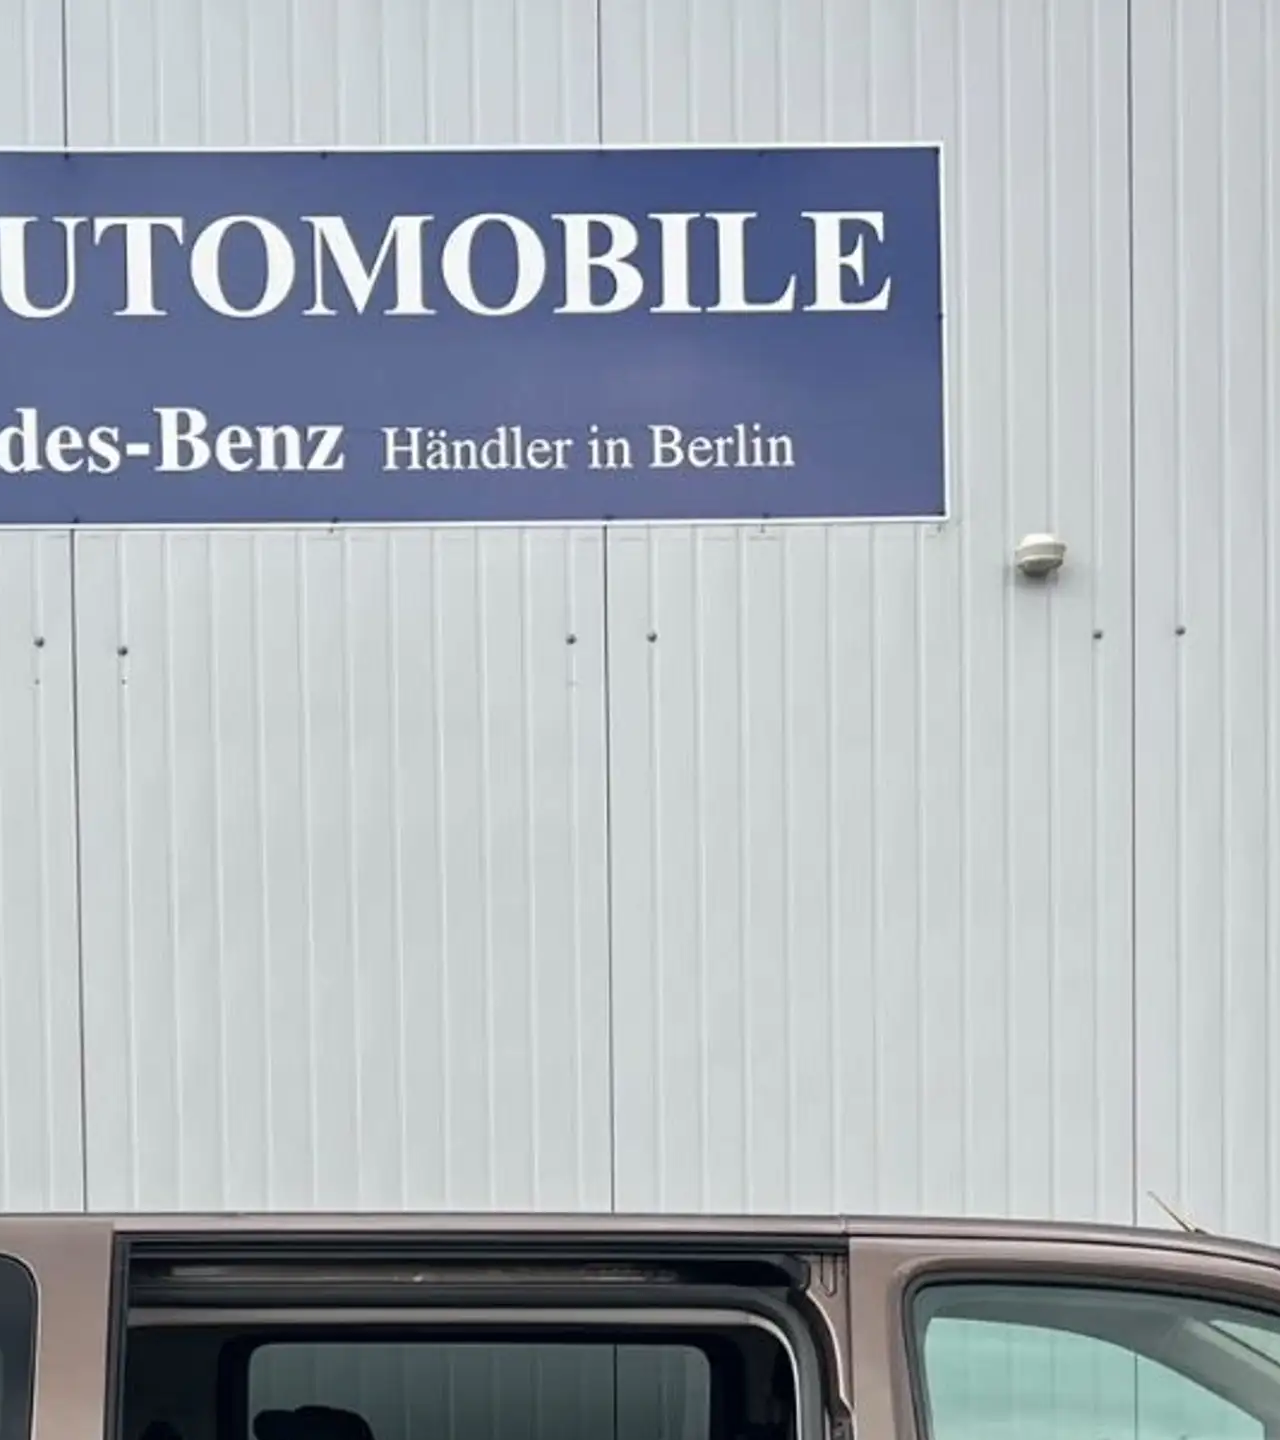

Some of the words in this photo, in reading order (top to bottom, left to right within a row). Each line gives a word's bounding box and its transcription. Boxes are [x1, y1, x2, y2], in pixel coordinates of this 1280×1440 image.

[381, 424, 574, 472] Händler
[587, 423, 634, 471] in
[648, 421, 797, 470] Berlin
